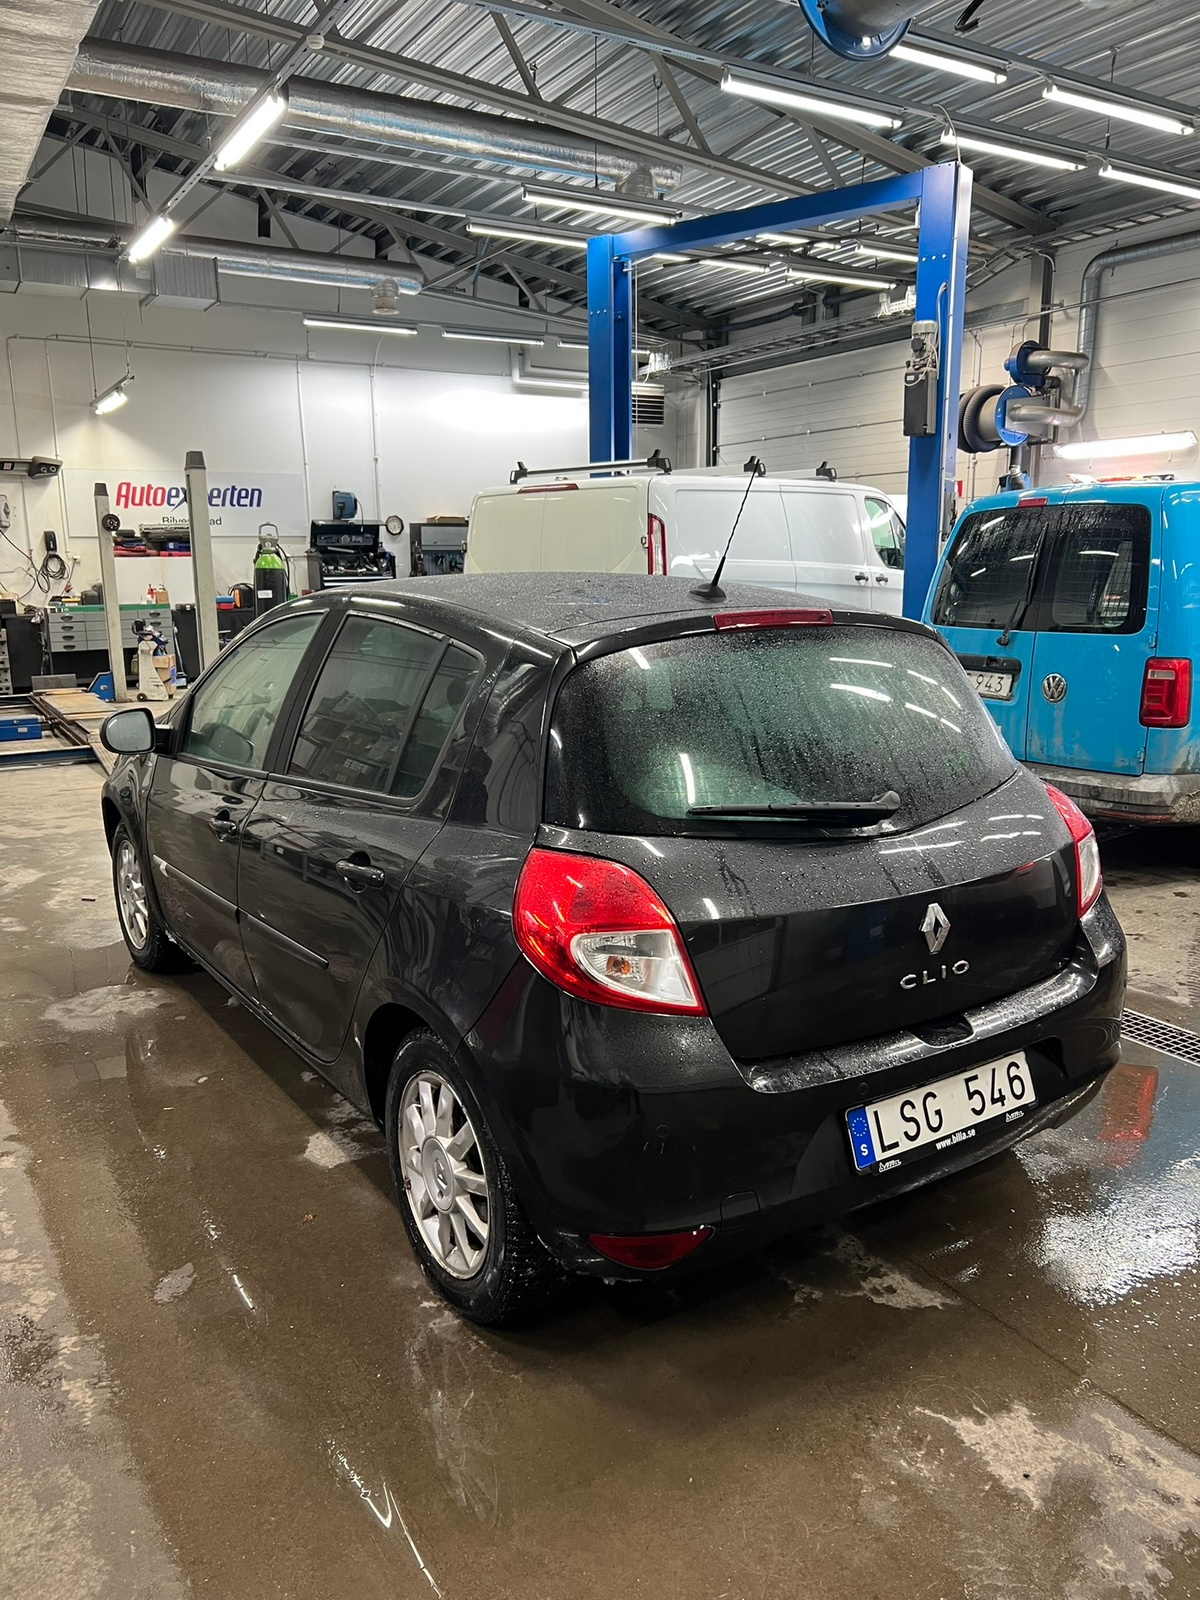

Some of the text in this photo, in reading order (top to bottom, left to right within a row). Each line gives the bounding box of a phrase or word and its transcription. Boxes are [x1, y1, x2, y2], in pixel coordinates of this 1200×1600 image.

[115, 482, 262, 512] Autoexerten
[900, 960, 970, 989] CLIO
[873, 1061, 1026, 1153] LSG 546
[860, 1143, 869, 1157] S
